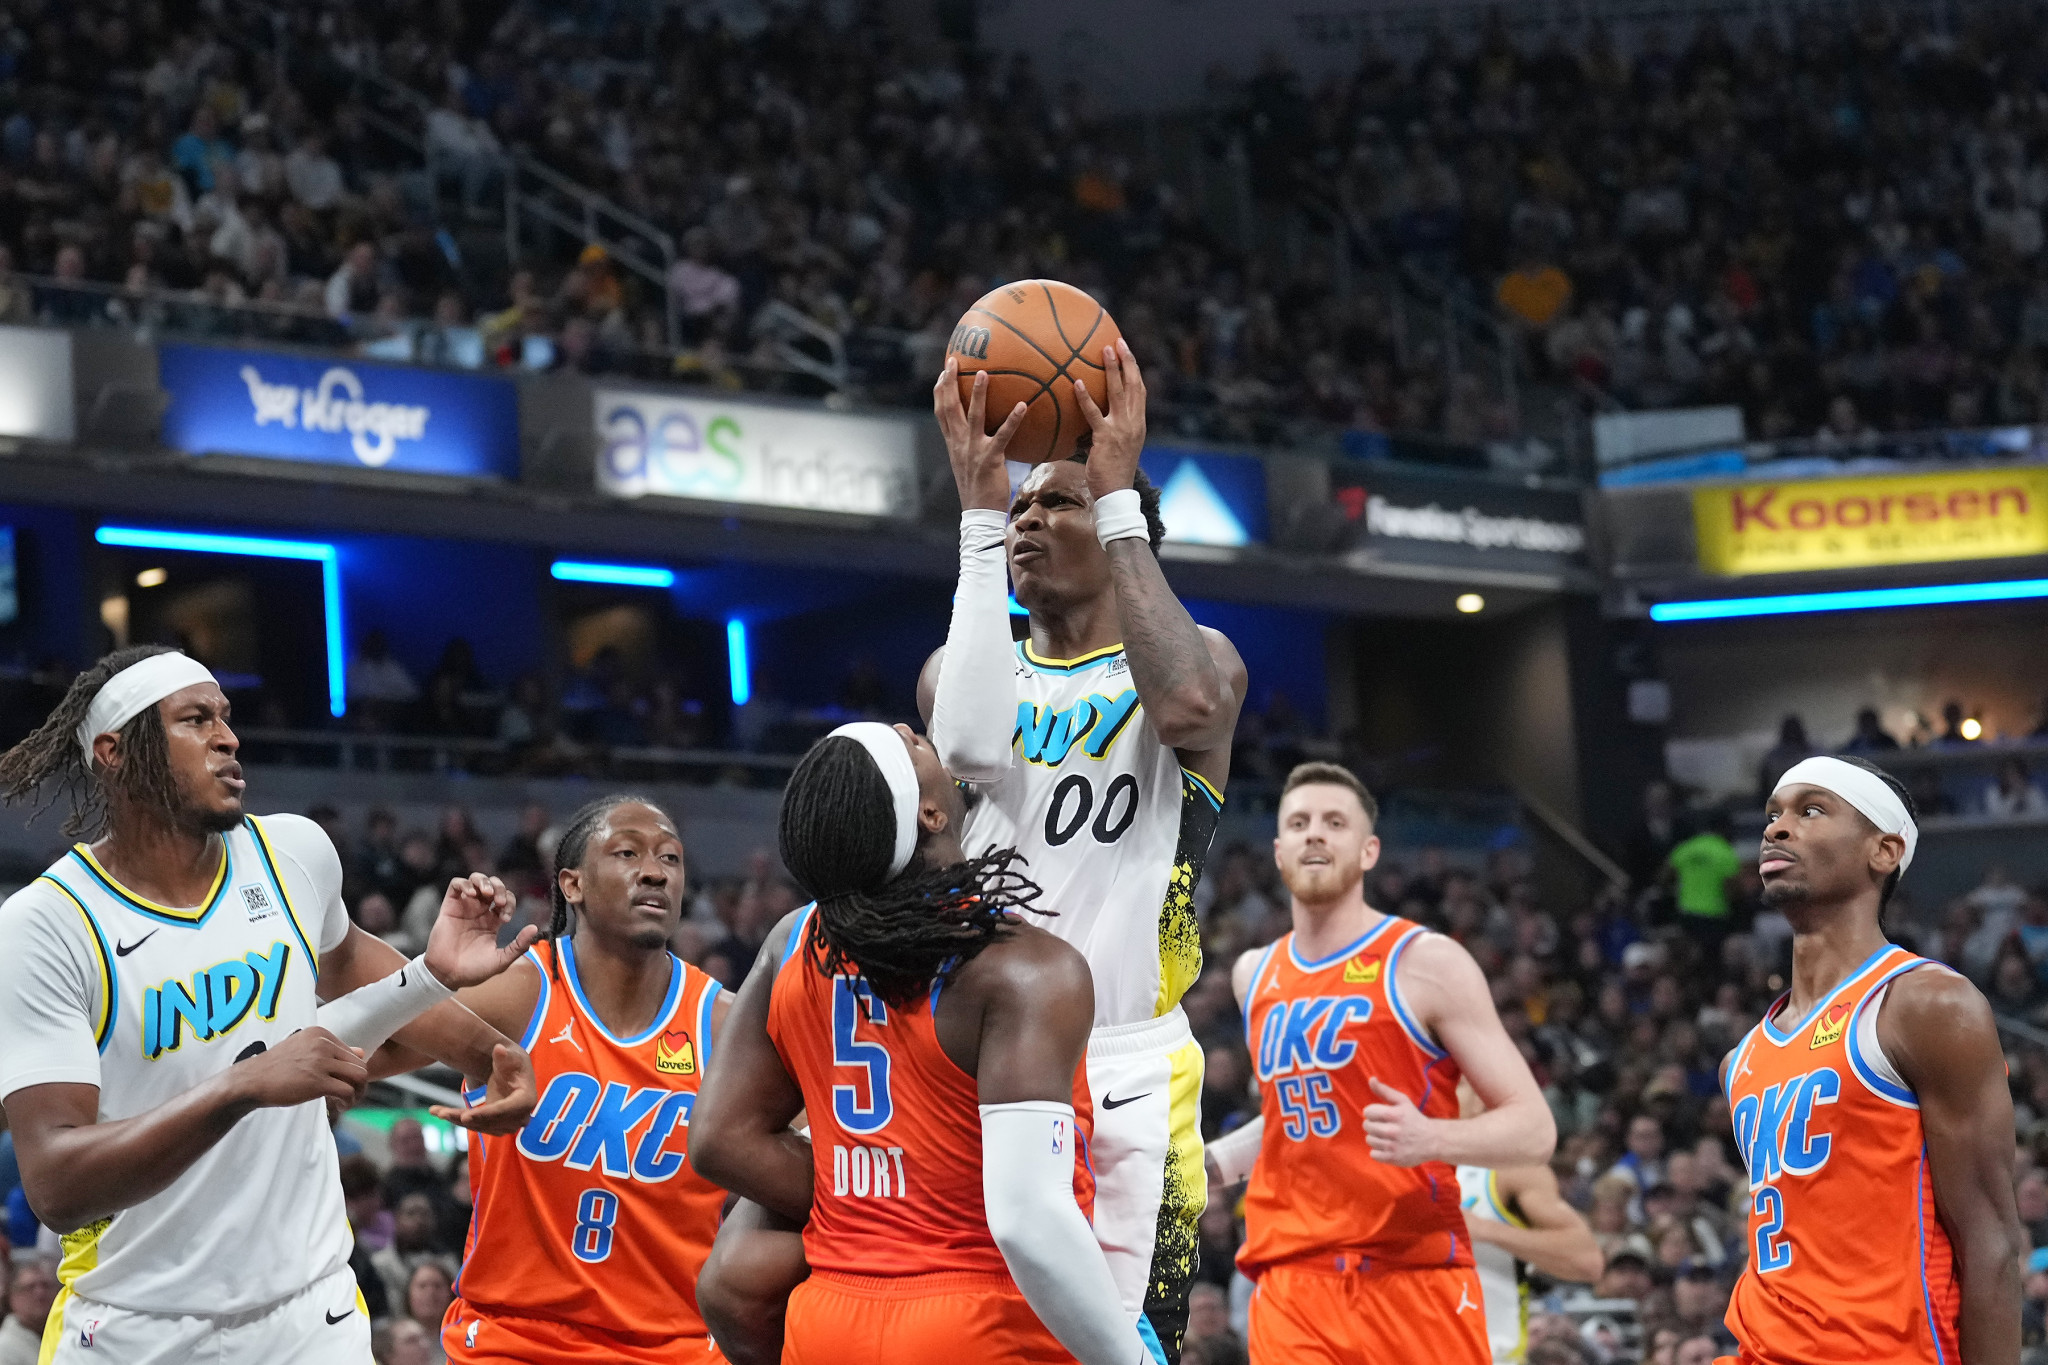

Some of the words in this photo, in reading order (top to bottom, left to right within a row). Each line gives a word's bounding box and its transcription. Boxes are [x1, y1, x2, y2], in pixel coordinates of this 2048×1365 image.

[605, 405, 744, 493] aes
[1731, 487, 2028, 532] Koorsen
[1012, 687, 1141, 768] NDY
[1045, 774, 1139, 846] 00
[142, 939, 291, 1061] INDY
[1258, 994, 1374, 1083] OKC
[832, 974, 893, 1134] 5
[516, 1072, 696, 1183] OKC
[1275, 1071, 1341, 1143] 55
[1733, 1067, 1840, 1192] OKC
[834, 1145, 906, 1198] DORT
[571, 1188, 619, 1263] 8
[1755, 1185, 1792, 1274] 2
